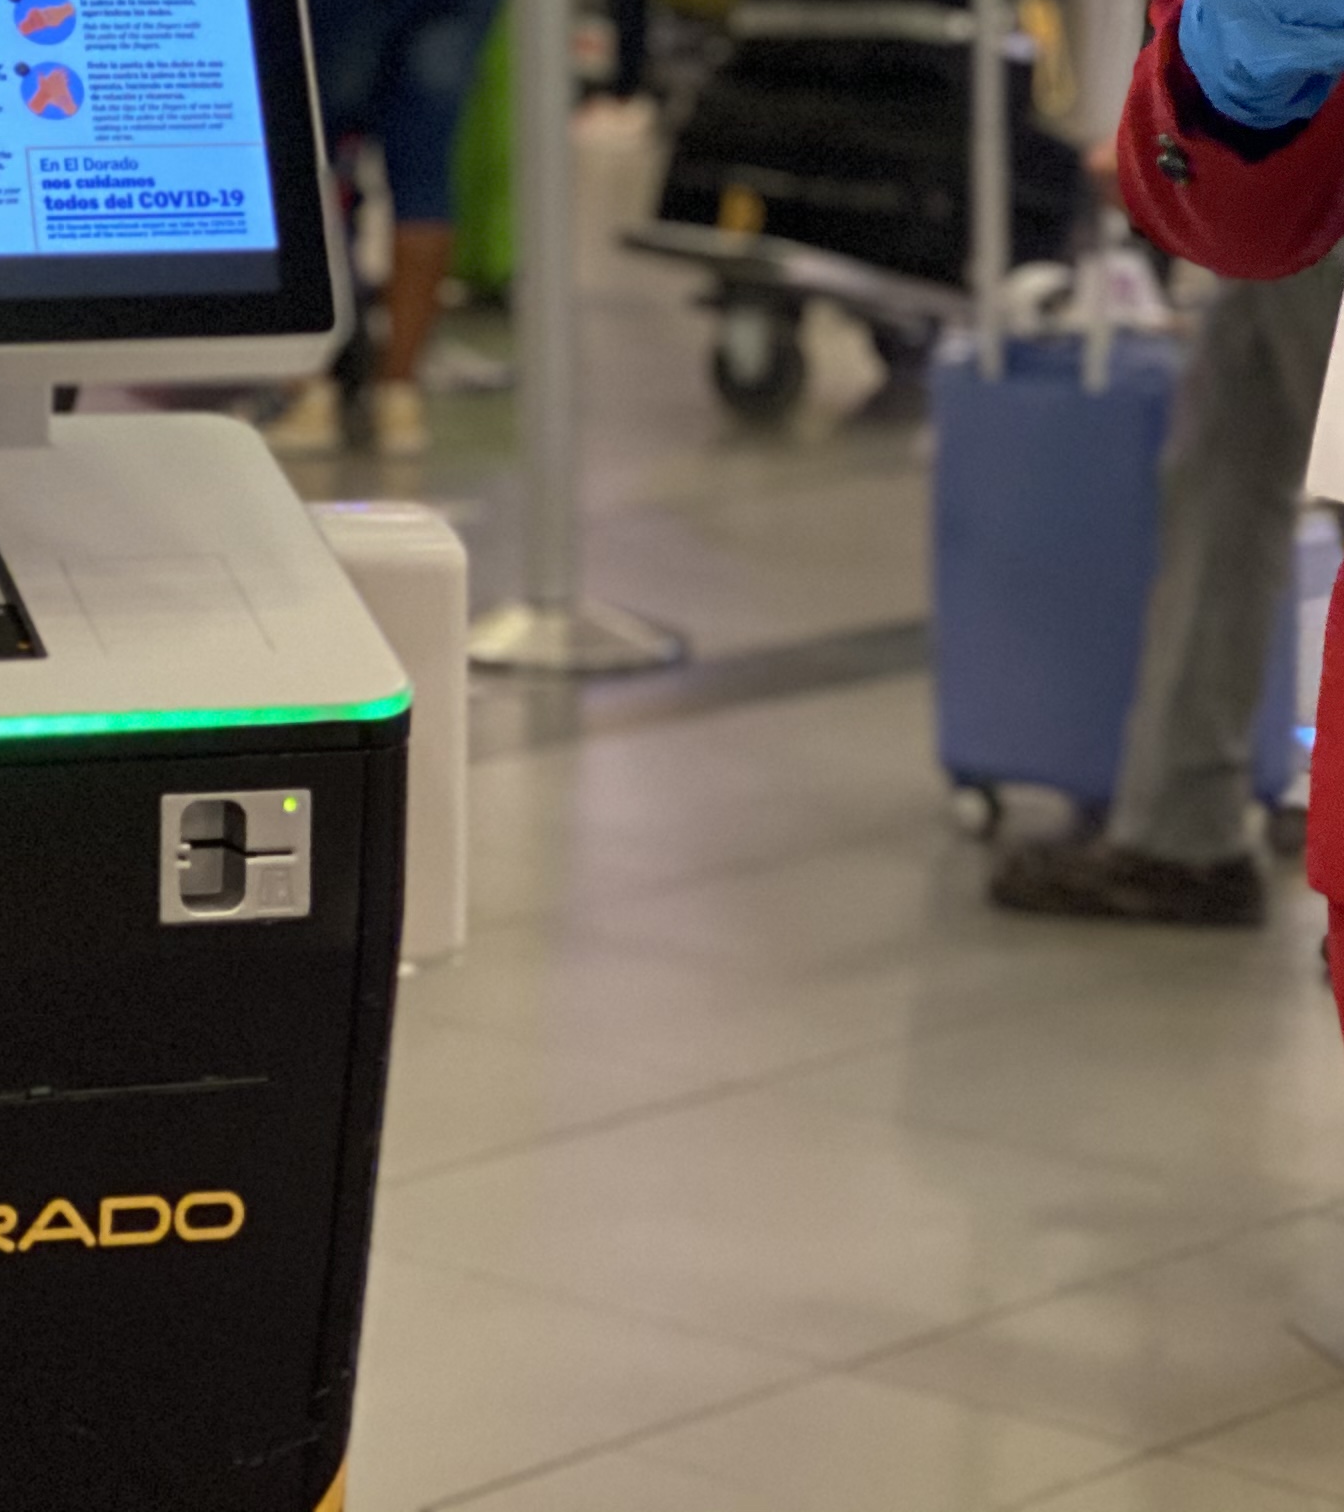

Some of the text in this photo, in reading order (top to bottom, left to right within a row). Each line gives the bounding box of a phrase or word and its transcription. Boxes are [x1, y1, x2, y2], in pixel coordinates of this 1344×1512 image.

[40, 157, 139, 172] En El Dorado
[42, 175, 156, 189] nos cuidamos
[43, 190, 244, 210] todos del COVID-19
